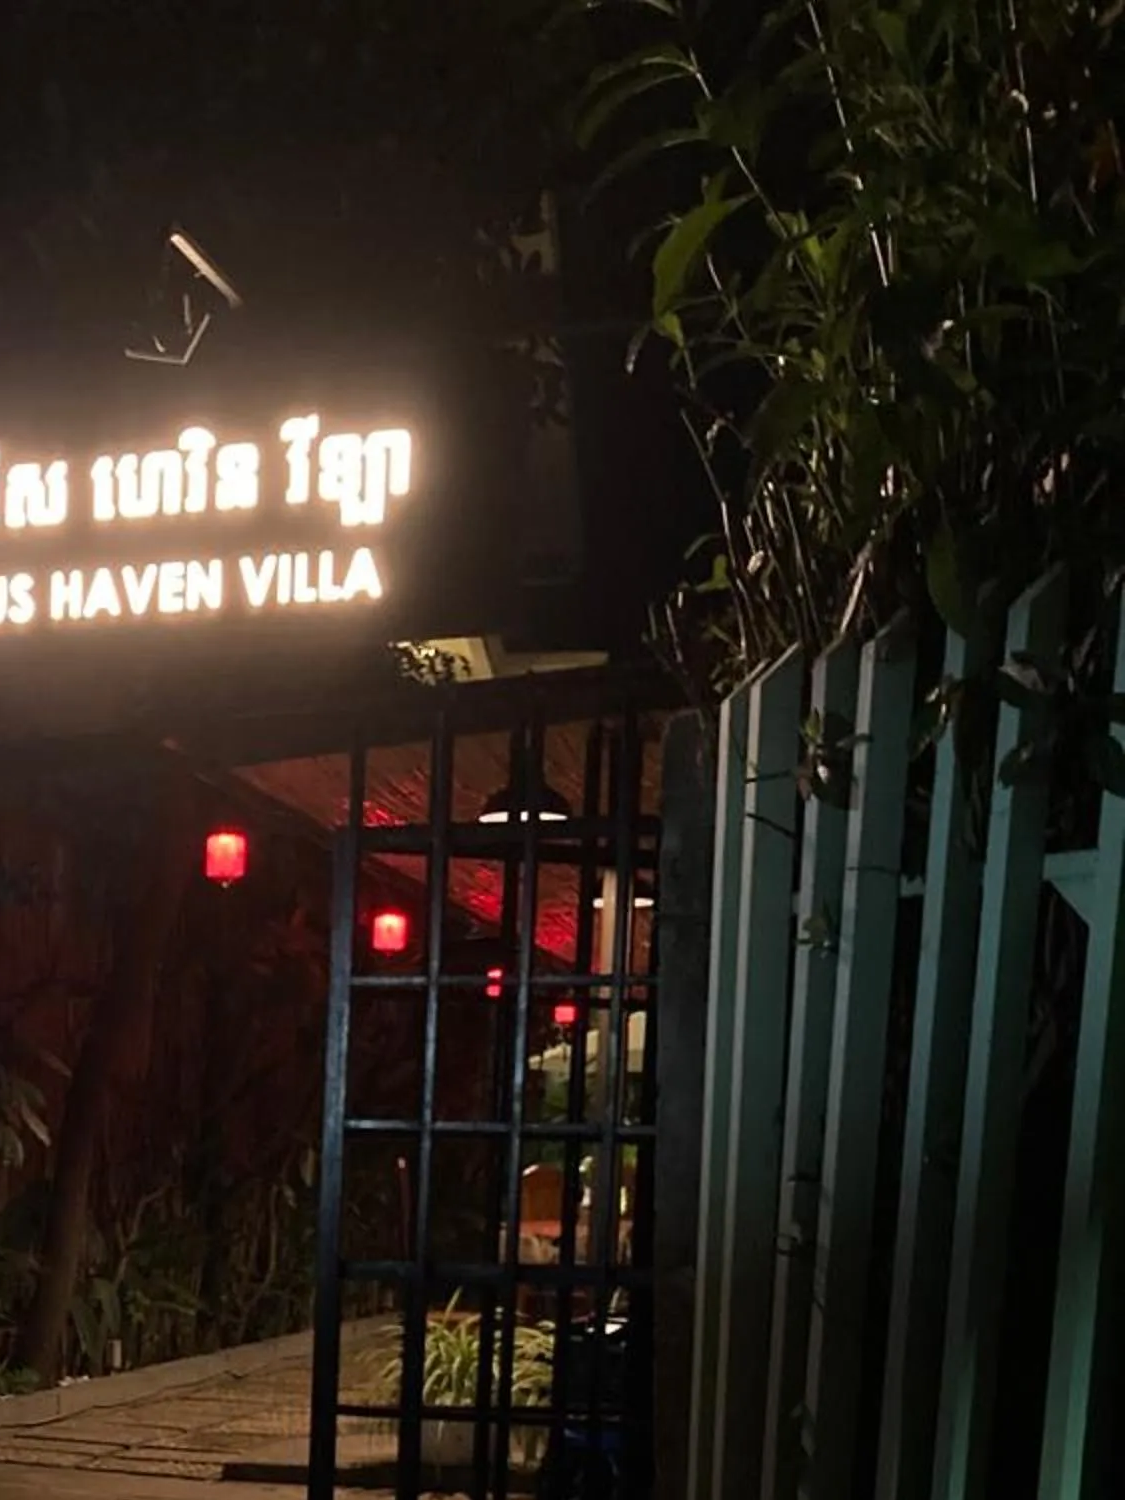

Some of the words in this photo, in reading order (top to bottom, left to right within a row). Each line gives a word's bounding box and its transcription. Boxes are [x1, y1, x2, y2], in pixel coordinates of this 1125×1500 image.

[280, 414, 412, 526] វីឡា
[49, 560, 224, 621] HAVEN
[239, 548, 383, 607] VILLA
